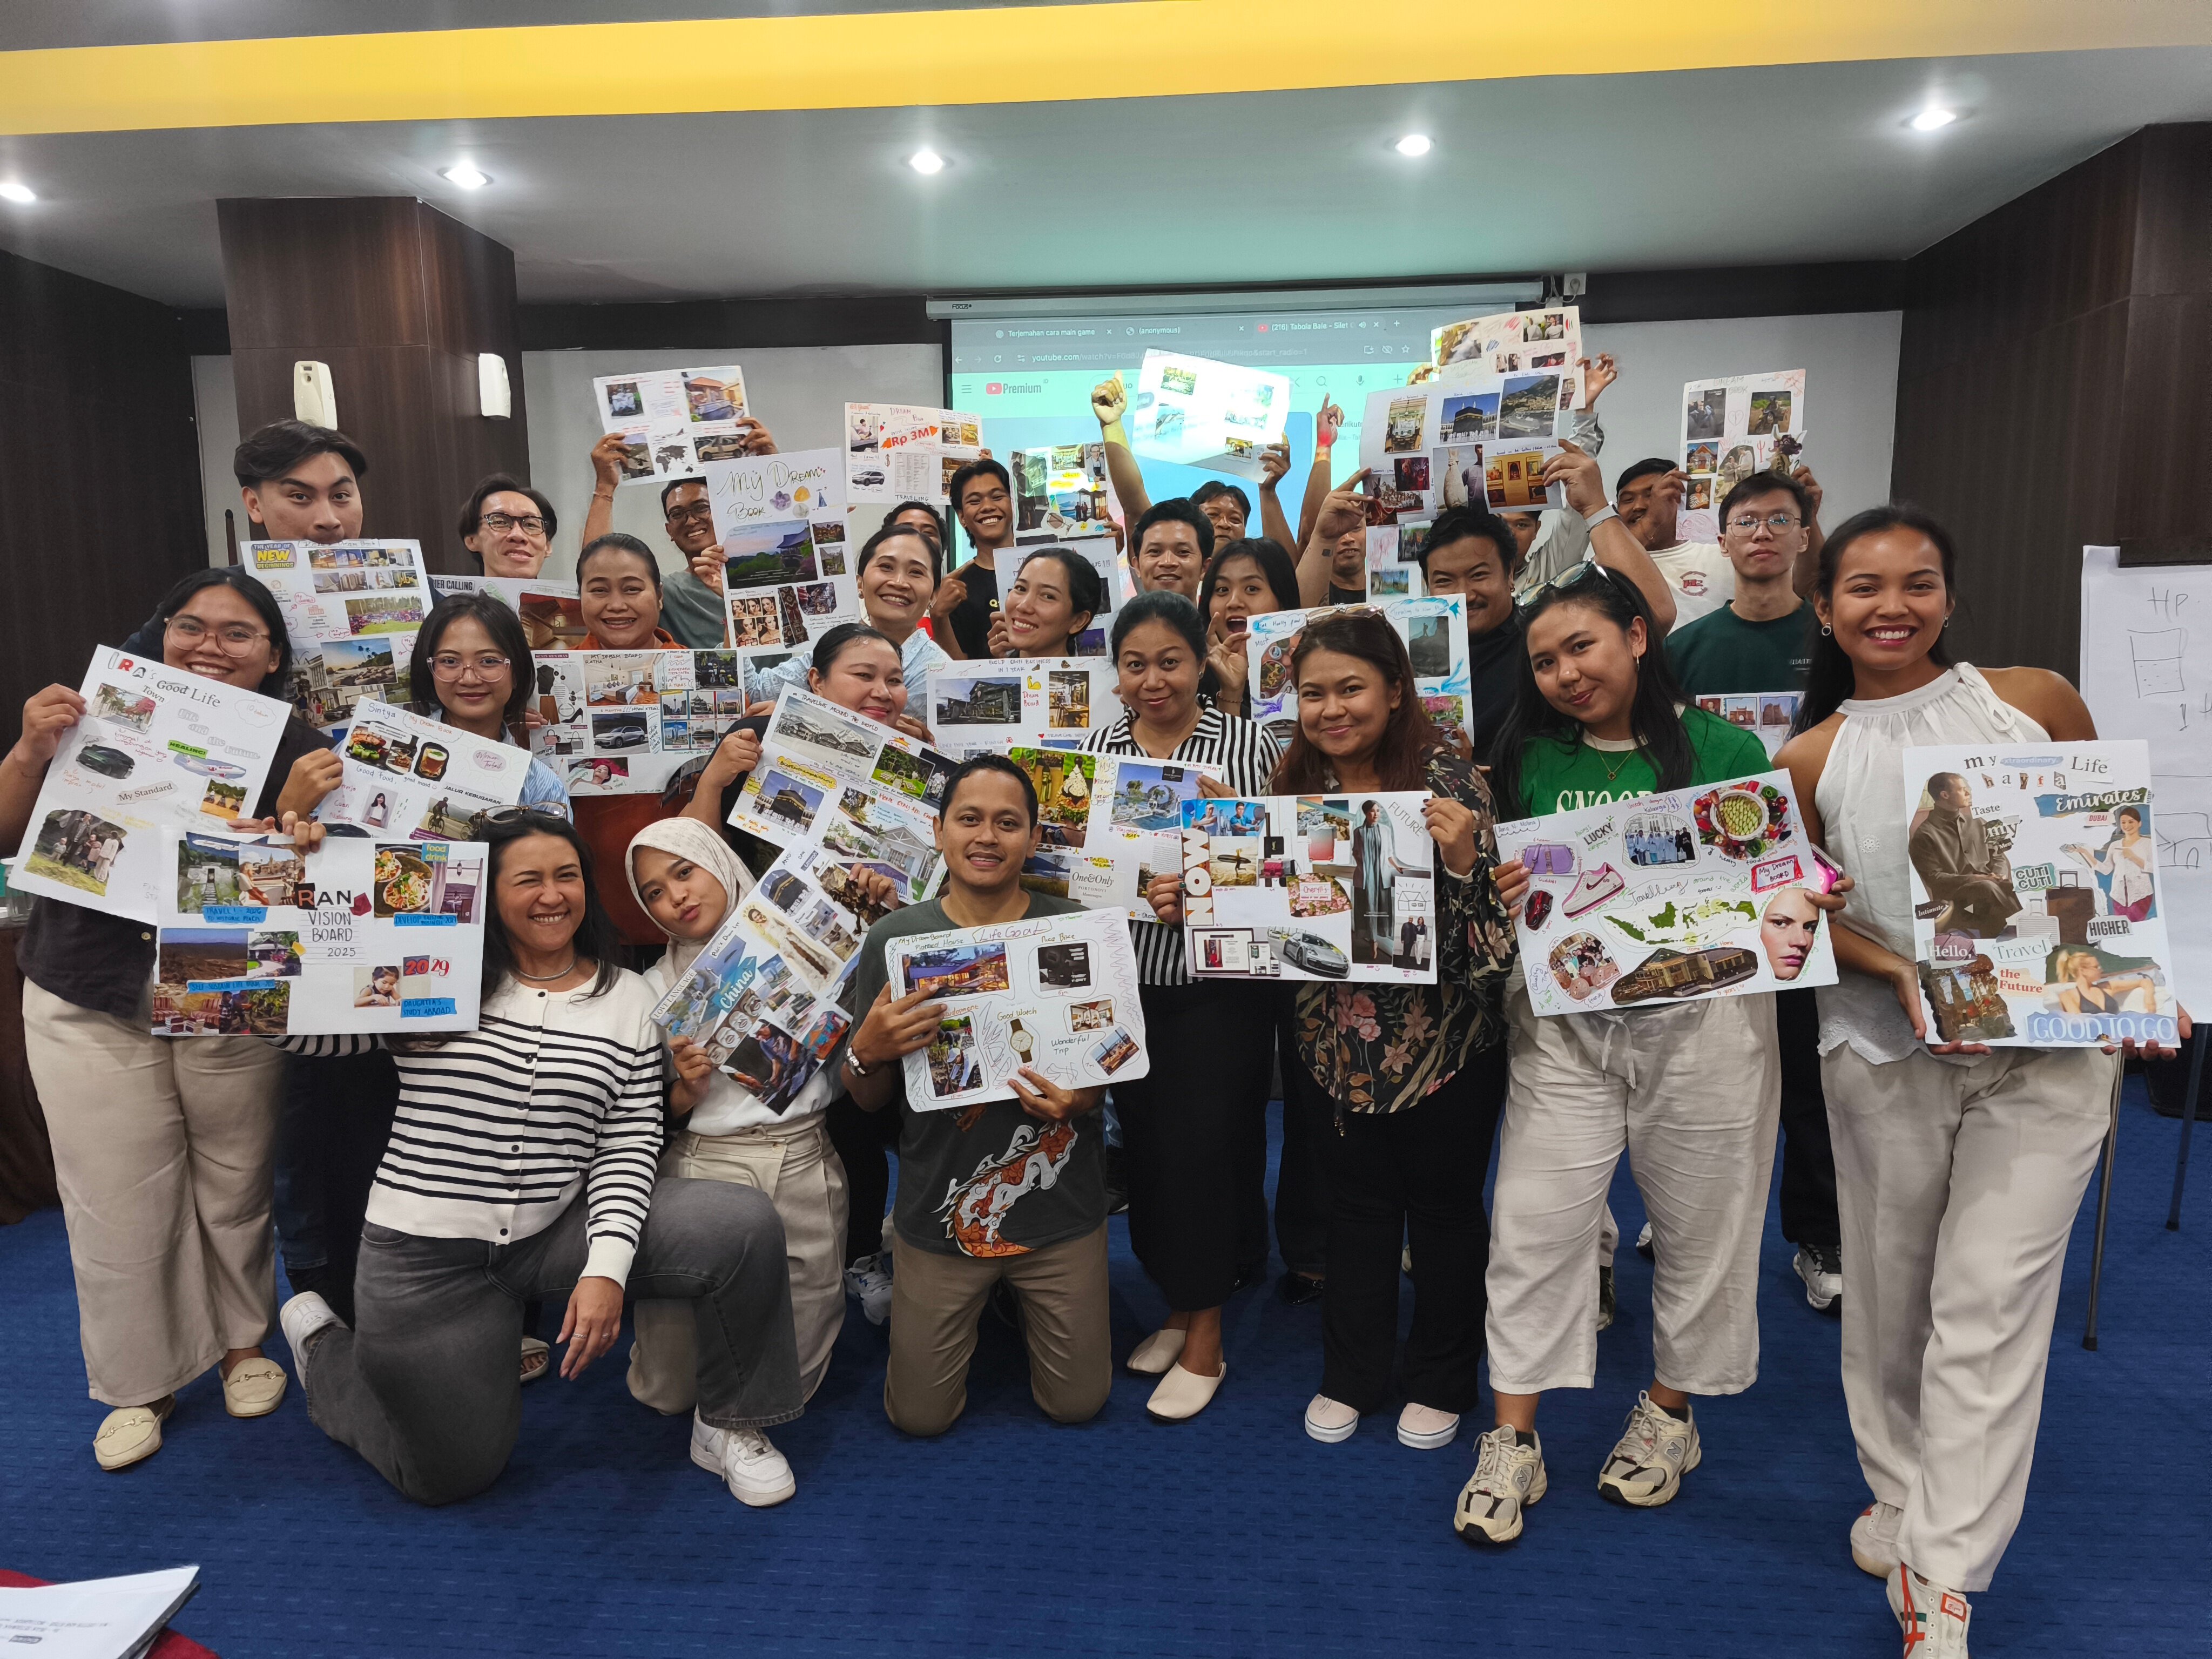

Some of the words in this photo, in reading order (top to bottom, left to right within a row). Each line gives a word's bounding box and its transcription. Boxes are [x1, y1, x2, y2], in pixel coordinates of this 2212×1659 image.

[1008, 329, 1044, 338] Terjemahan
[1138, 327, 1181, 335] (anonymous)
[1003, 383, 1041, 394] Premium
[895, 494, 929, 502] TRAVELING
[257, 549, 291, 562] NEW
[256, 562, 294, 570] BEGINNINGS
[447, 580, 473, 591] CALLING
[142, 685, 165, 703] Town
[157, 680, 188, 695] Good
[190, 688, 221, 707] Life
[1022, 691, 1039, 699] Dream
[830, 706, 849, 718] AROUND
[368, 703, 396, 719] Sintya
[409, 716, 417, 724] My
[438, 725, 453, 735] Book
[1100, 762, 1110, 772] MY
[1964, 755, 1997, 770] my
[2071, 756, 2109, 774] Life
[356, 764, 374, 777] Good
[417, 780, 430, 789] mood
[118, 791, 133, 804] My
[134, 783, 173, 798] Standard
[443, 785, 463, 794] JALUR
[464, 791, 502, 805] KEBUGARAN
[2055, 790, 2142, 811] Emirates
[1972, 804, 2000, 817] Taste
[1388, 801, 1425, 837] FUTURE
[1583, 822, 1614, 845] LUCKY
[426, 844, 447, 853] food
[1998, 841, 2013, 849] Men
[425, 853, 448, 862] drink
[1758, 867, 1770, 877] My
[1771, 859, 1793, 871] Dream
[2015, 866, 2049, 879] CUTI
[1071, 872, 1115, 888] One&Only
[1183, 828, 1214, 926] NOW
[1692, 876, 1715, 885] around
[2018, 876, 2052, 889] CUTI
[298, 889, 352, 907] RAN
[1918, 904, 1945, 916] Intimate
[308, 911, 352, 926] VISION
[395, 915, 421, 925] DEVELOP
[979, 925, 1002, 942] Life
[2089, 920, 2130, 936] HIGHER
[312, 928, 353, 943] BOARD
[898, 936, 909, 945] My
[943, 938, 964, 948] House
[327, 947, 356, 957] 2025
[1928, 944, 1972, 959] Hello,
[1993, 940, 2048, 960] Travel
[2000, 968, 2021, 979] the
[720, 969, 753, 1009] China
[1999, 980, 2043, 994] Future
[654, 1000, 670, 1018] LOVE
[667, 971, 695, 1002] LANGUAGE
[403, 1008, 421, 1016] STUDY
[424, 1006, 451, 1016] ABROAD
[997, 1010, 1014, 1021] Good
[1016, 1006, 1037, 1017] Watch
[2033, 1017, 2101, 1040] GOOD
[2107, 1017, 2134, 1039] TO
[2140, 1016, 2174, 1040] GO
[1051, 1034, 1090, 1047] Wonderful
[1054, 1047, 1069, 1056] Trip
